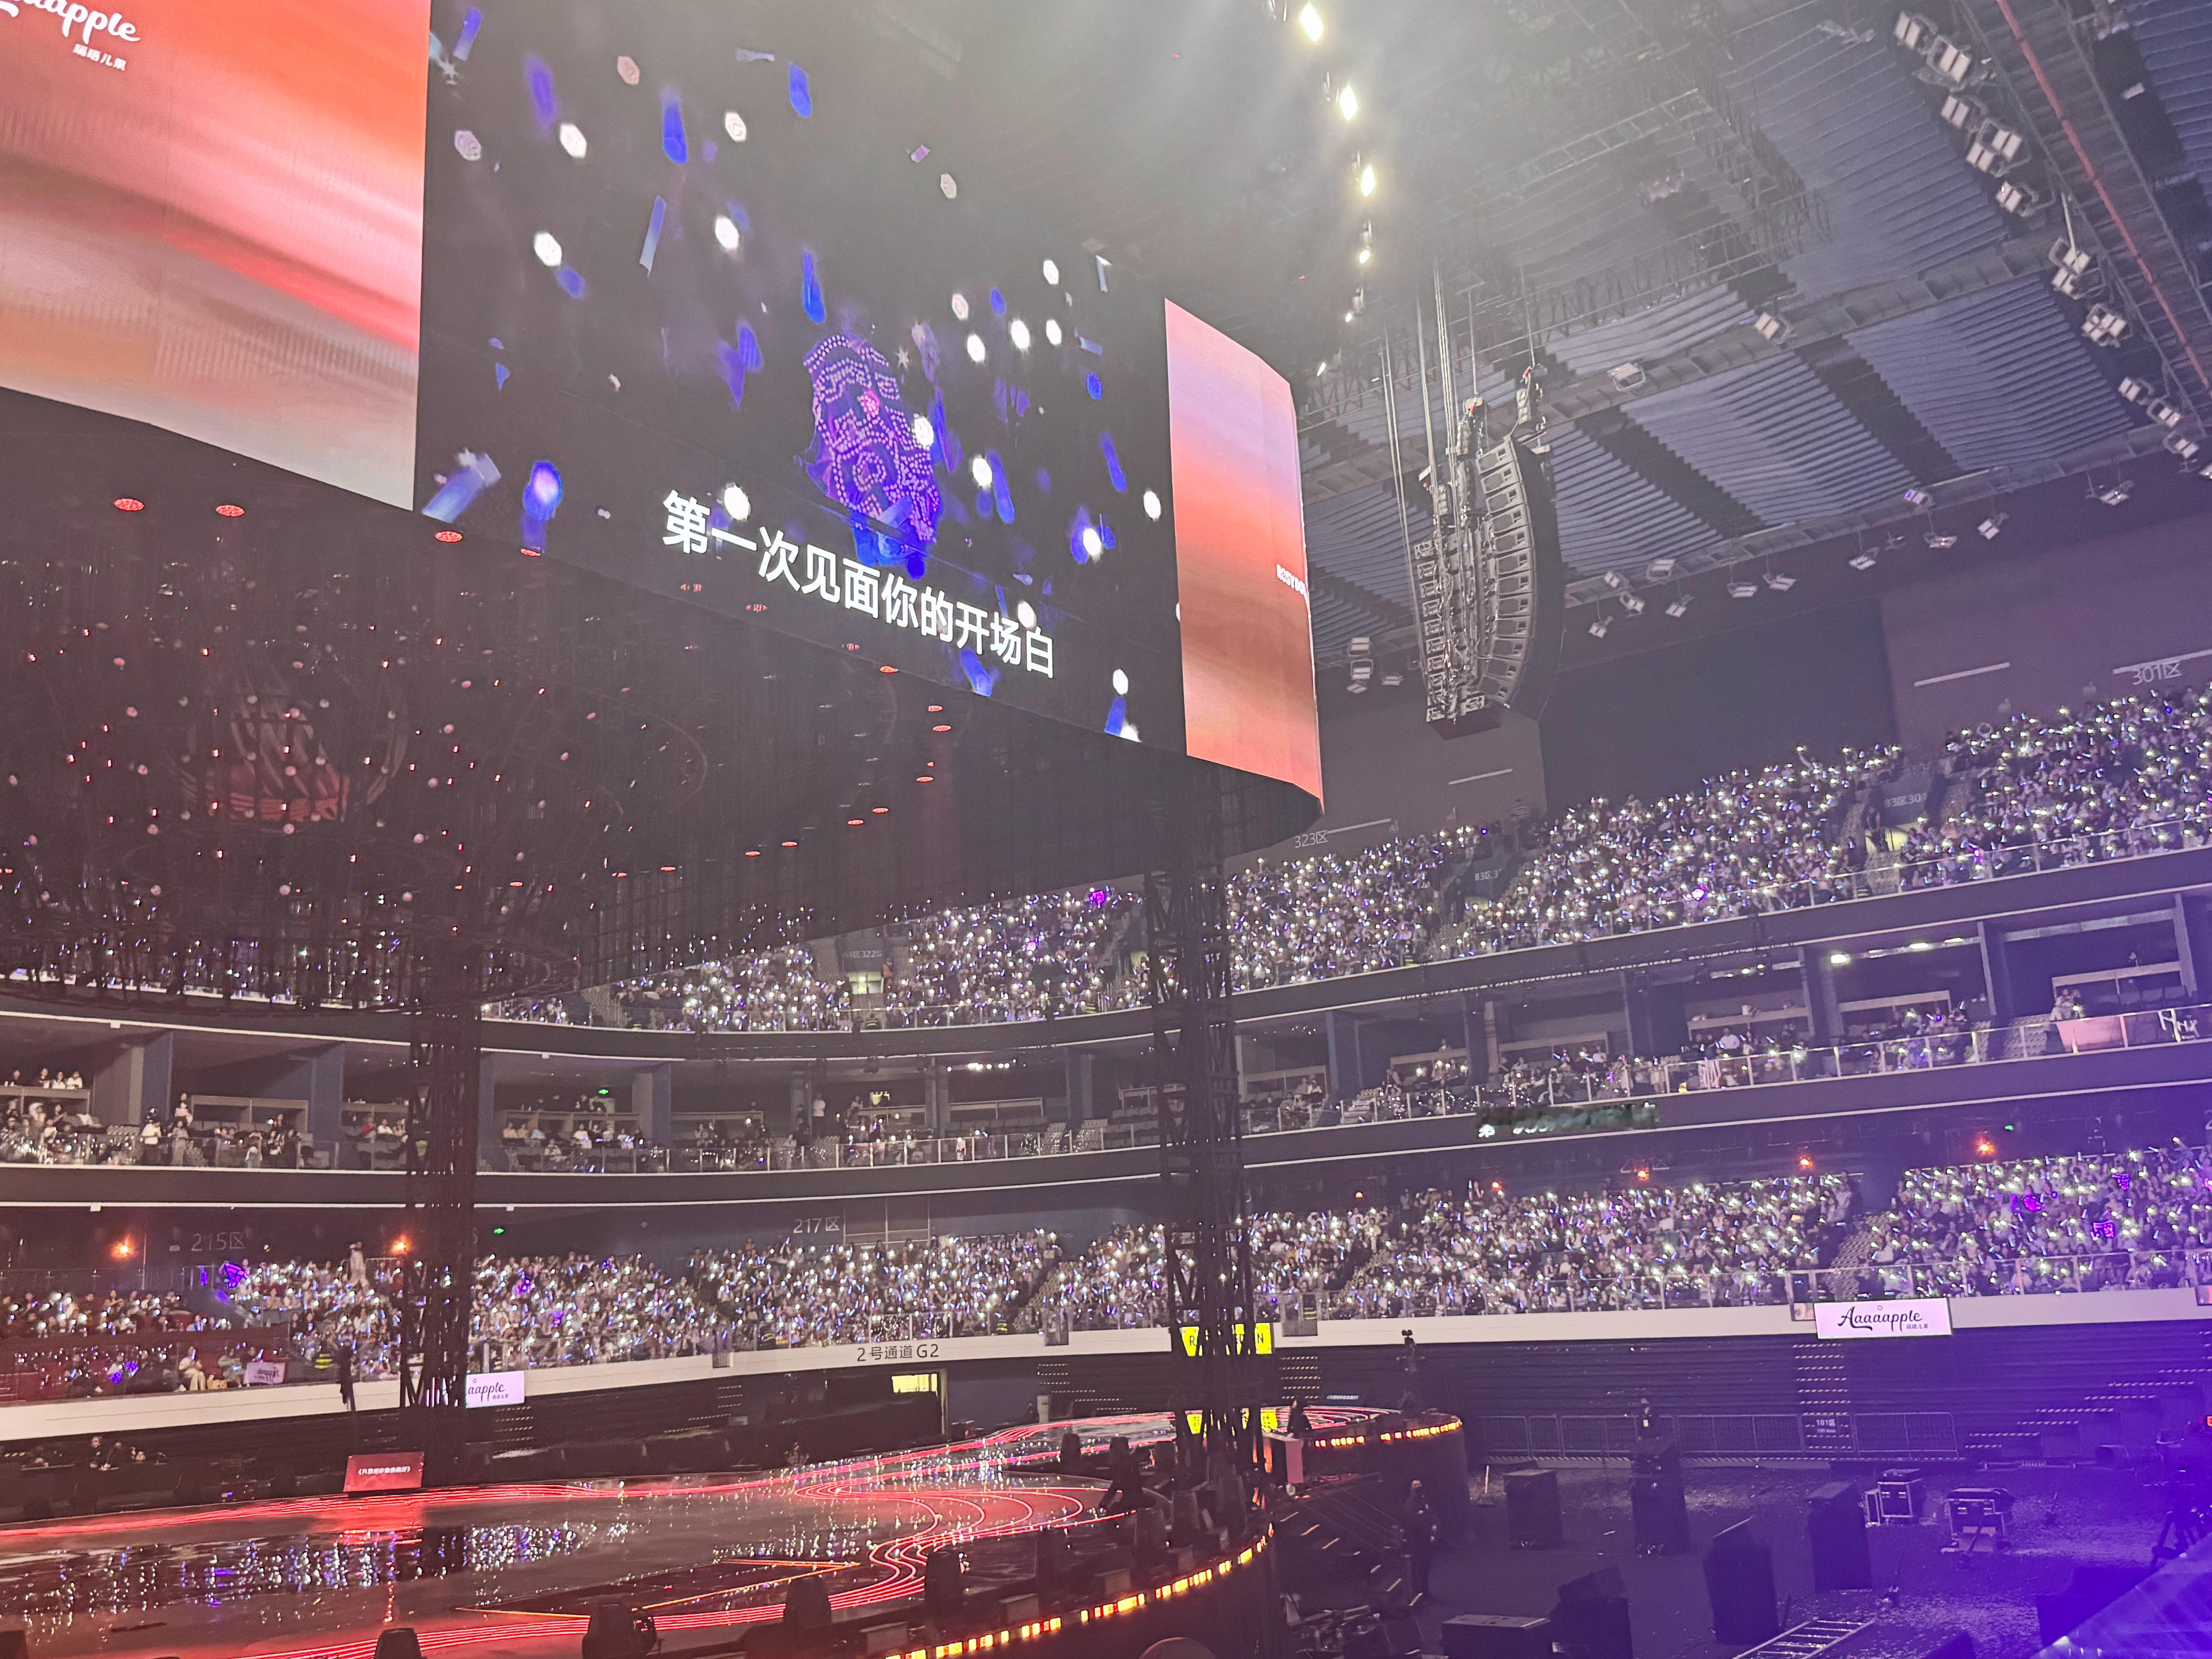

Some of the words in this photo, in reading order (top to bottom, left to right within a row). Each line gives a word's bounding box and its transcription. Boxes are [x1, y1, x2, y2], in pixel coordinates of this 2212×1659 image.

[662, 489, 1054, 678] 第一次见面你的开场白
[2131, 659, 2182, 685] 301区
[1295, 830, 1328, 848] 323区
[793, 1216, 840, 1233] 217区
[191, 1232, 246, 1251] 215区
[1838, 1306, 1923, 1331] Aaaaapple
[917, 1344, 939, 1358] G2
